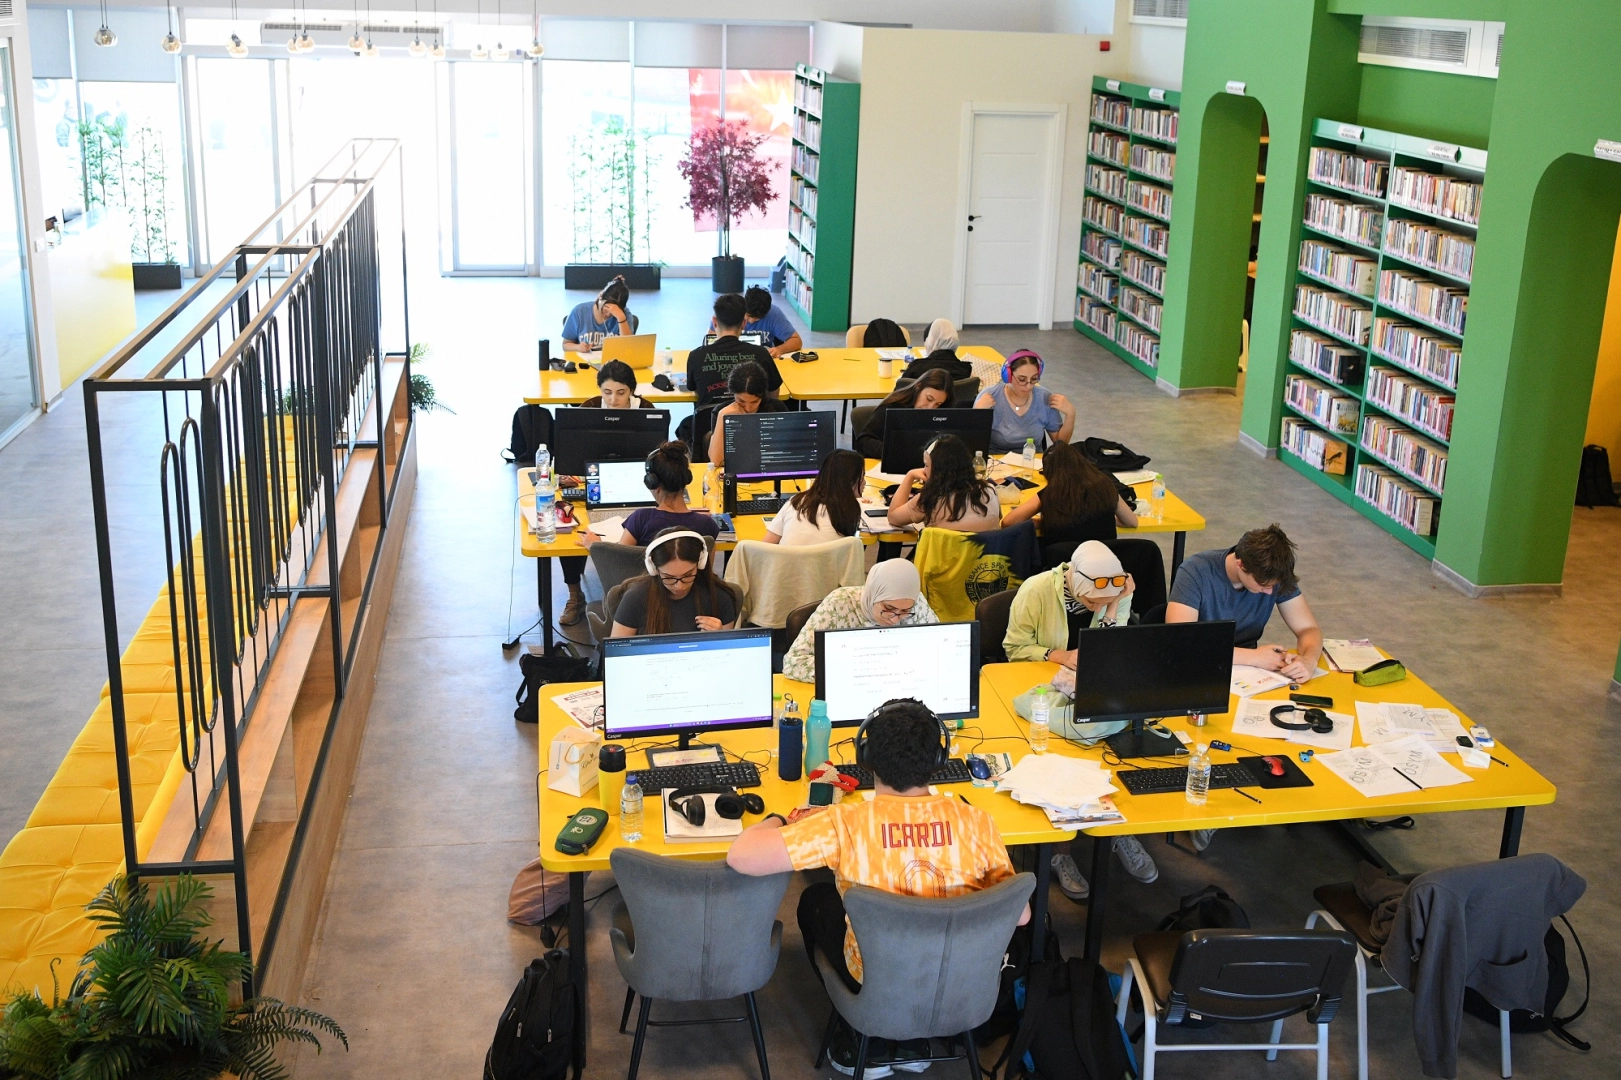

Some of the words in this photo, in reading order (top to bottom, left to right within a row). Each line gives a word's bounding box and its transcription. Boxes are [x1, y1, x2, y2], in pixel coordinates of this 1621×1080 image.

[704, 353, 738, 363] Alluring
[738, 353, 756, 361] beat
[702, 362, 717, 372] and
[881, 821, 953, 849] ICARDI
